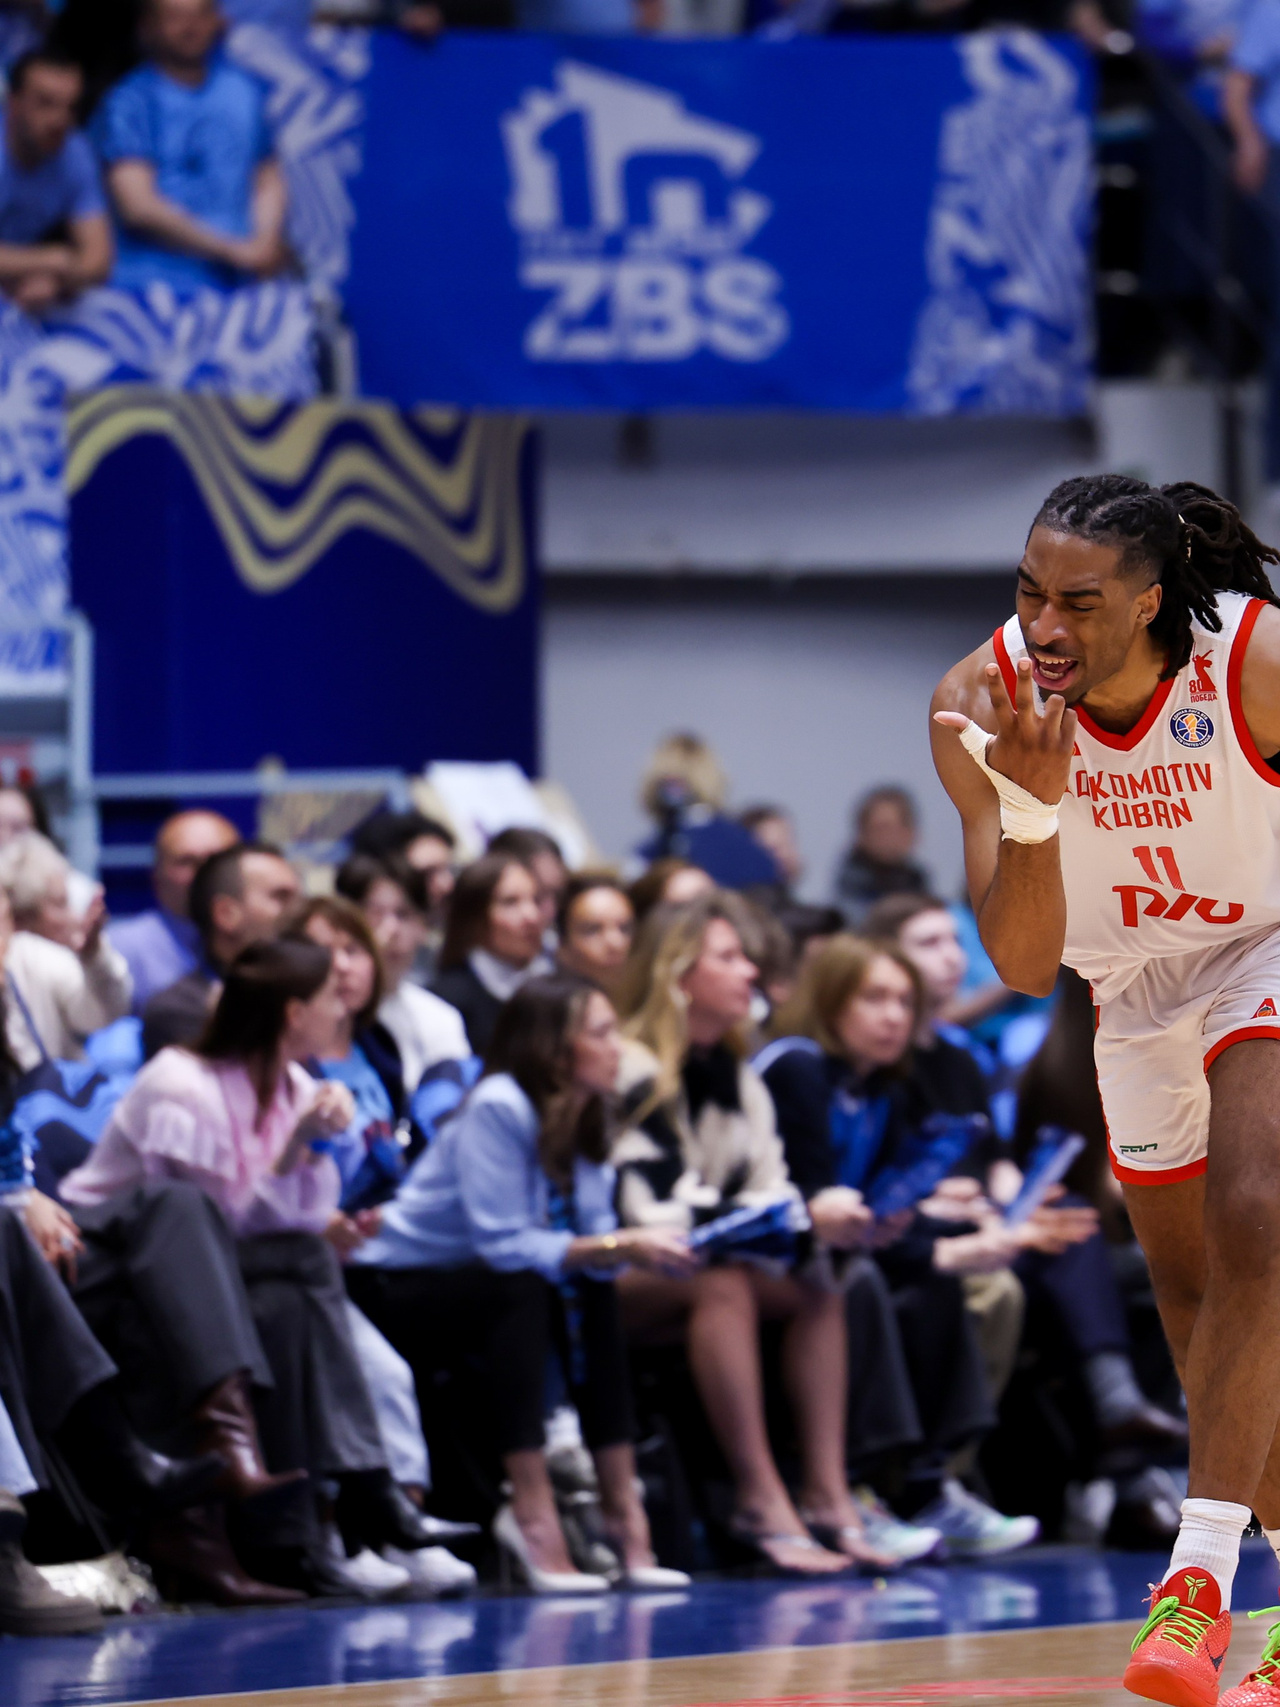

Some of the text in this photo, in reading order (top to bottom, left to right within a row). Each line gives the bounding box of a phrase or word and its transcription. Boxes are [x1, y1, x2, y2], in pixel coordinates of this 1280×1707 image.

[522, 260, 791, 363] ZBS
[1189, 679, 1204, 694] 80
[1190, 692, 1218, 703] ПОБЕДА
[1064, 763, 1213, 802] OKOMOTIV
[1091, 797, 1193, 831] KUBAN
[1131, 845, 1187, 893] 11
